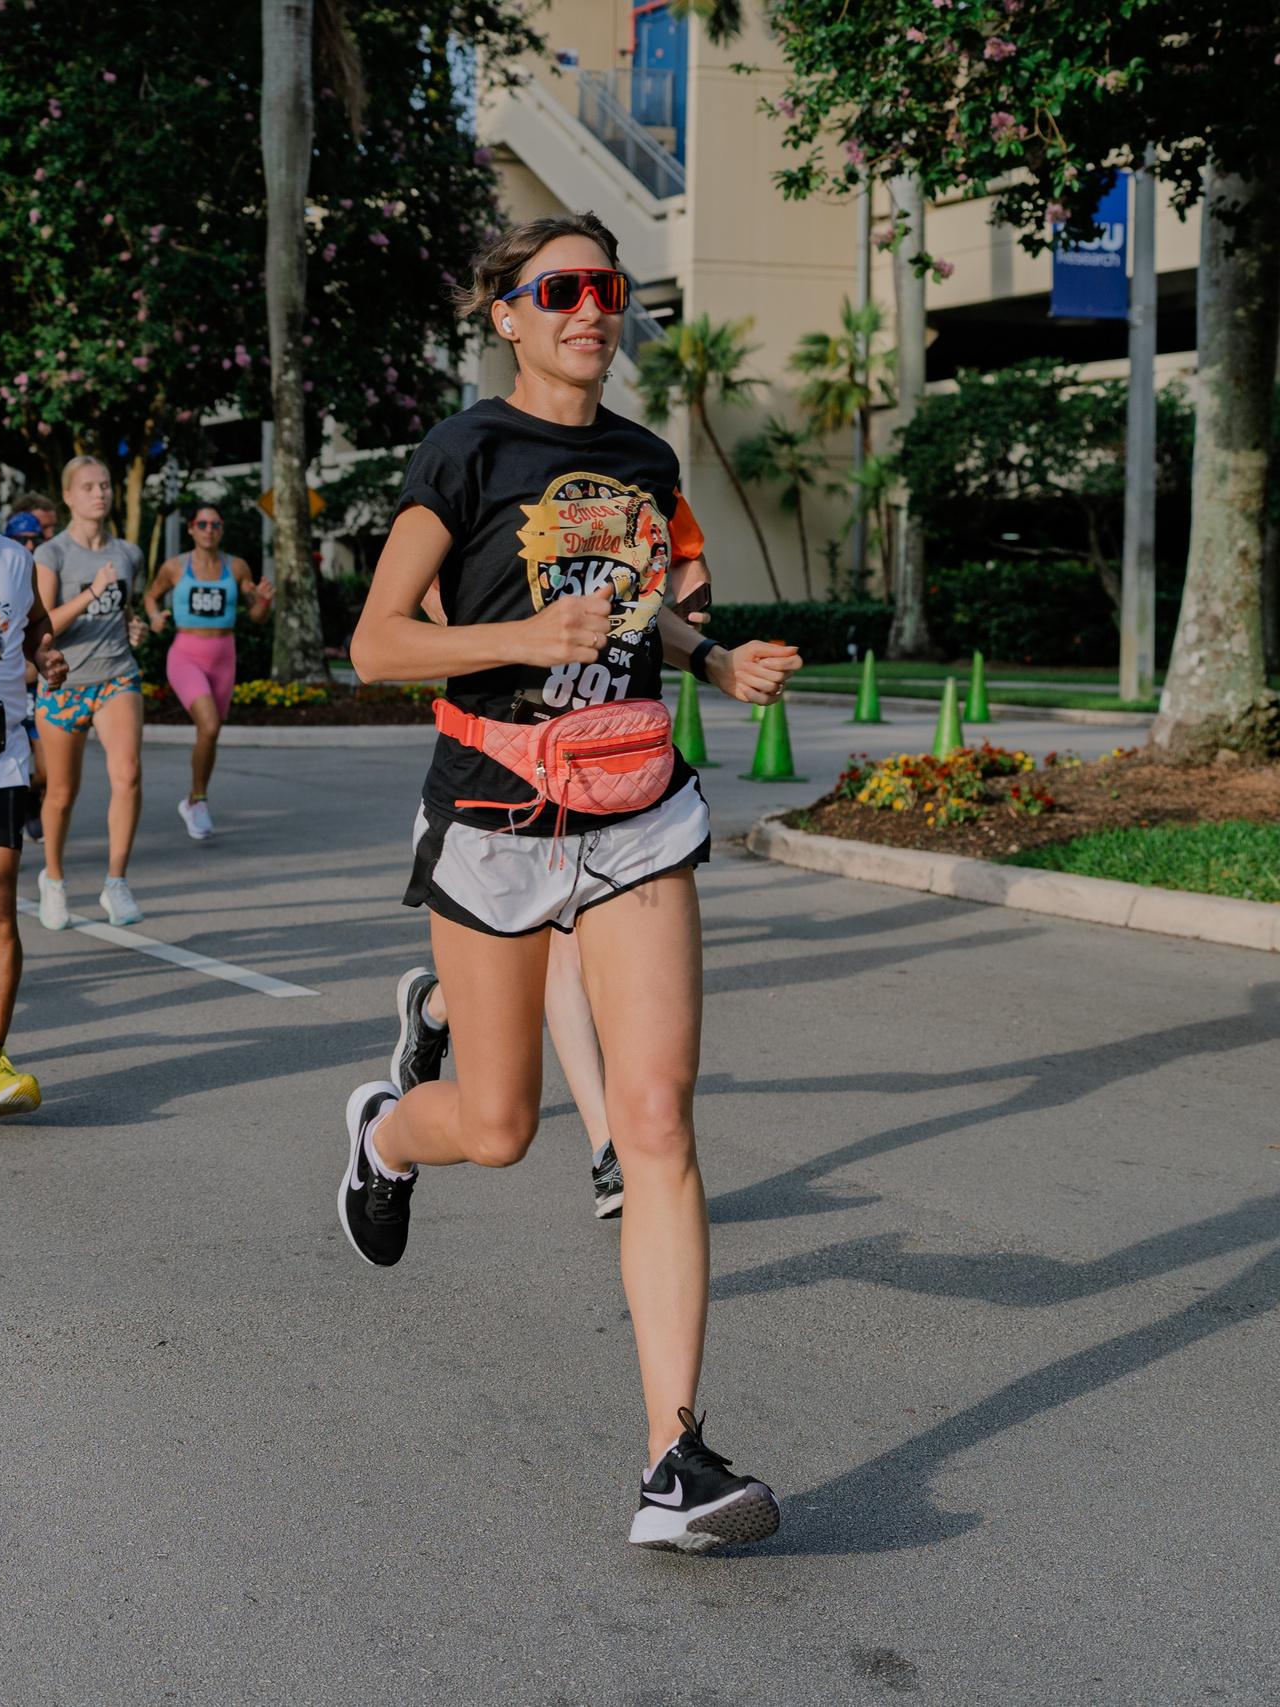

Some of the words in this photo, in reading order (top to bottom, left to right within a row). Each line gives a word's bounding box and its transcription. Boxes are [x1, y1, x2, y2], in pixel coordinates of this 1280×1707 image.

[1057, 251, 1121, 267] Research
[558, 502, 620, 524] Cinco
[591, 518, 604, 531] de
[563, 530, 622, 554] Drinko
[557, 560, 615, 599] 5K
[607, 647, 635, 669] 5K
[541, 661, 632, 711] 891
